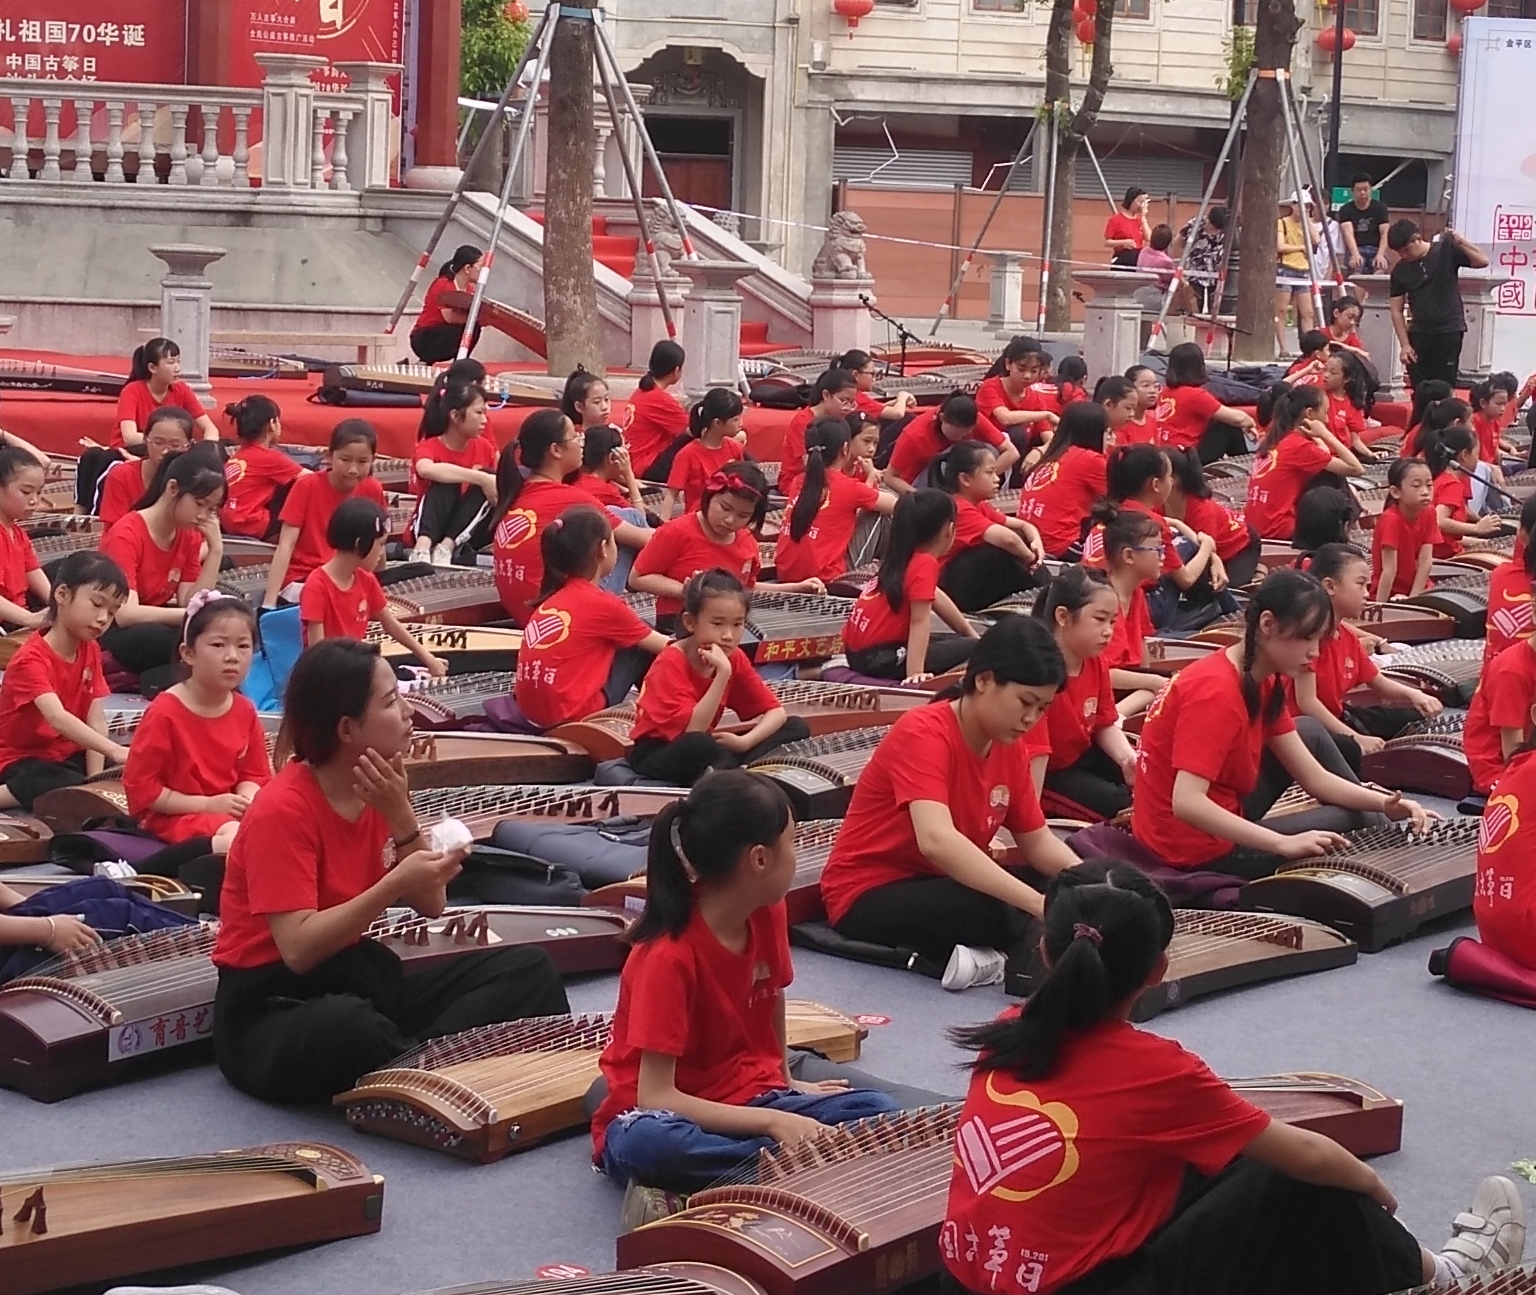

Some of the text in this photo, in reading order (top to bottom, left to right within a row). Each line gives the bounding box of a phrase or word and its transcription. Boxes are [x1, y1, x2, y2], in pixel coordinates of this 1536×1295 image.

[1506, 38, 1532, 49] 金平区
[6, 53, 96, 72] 中国古筝日
[1499, 215, 1532, 228] 2019
[541, 1264, 586, 1279] 194
